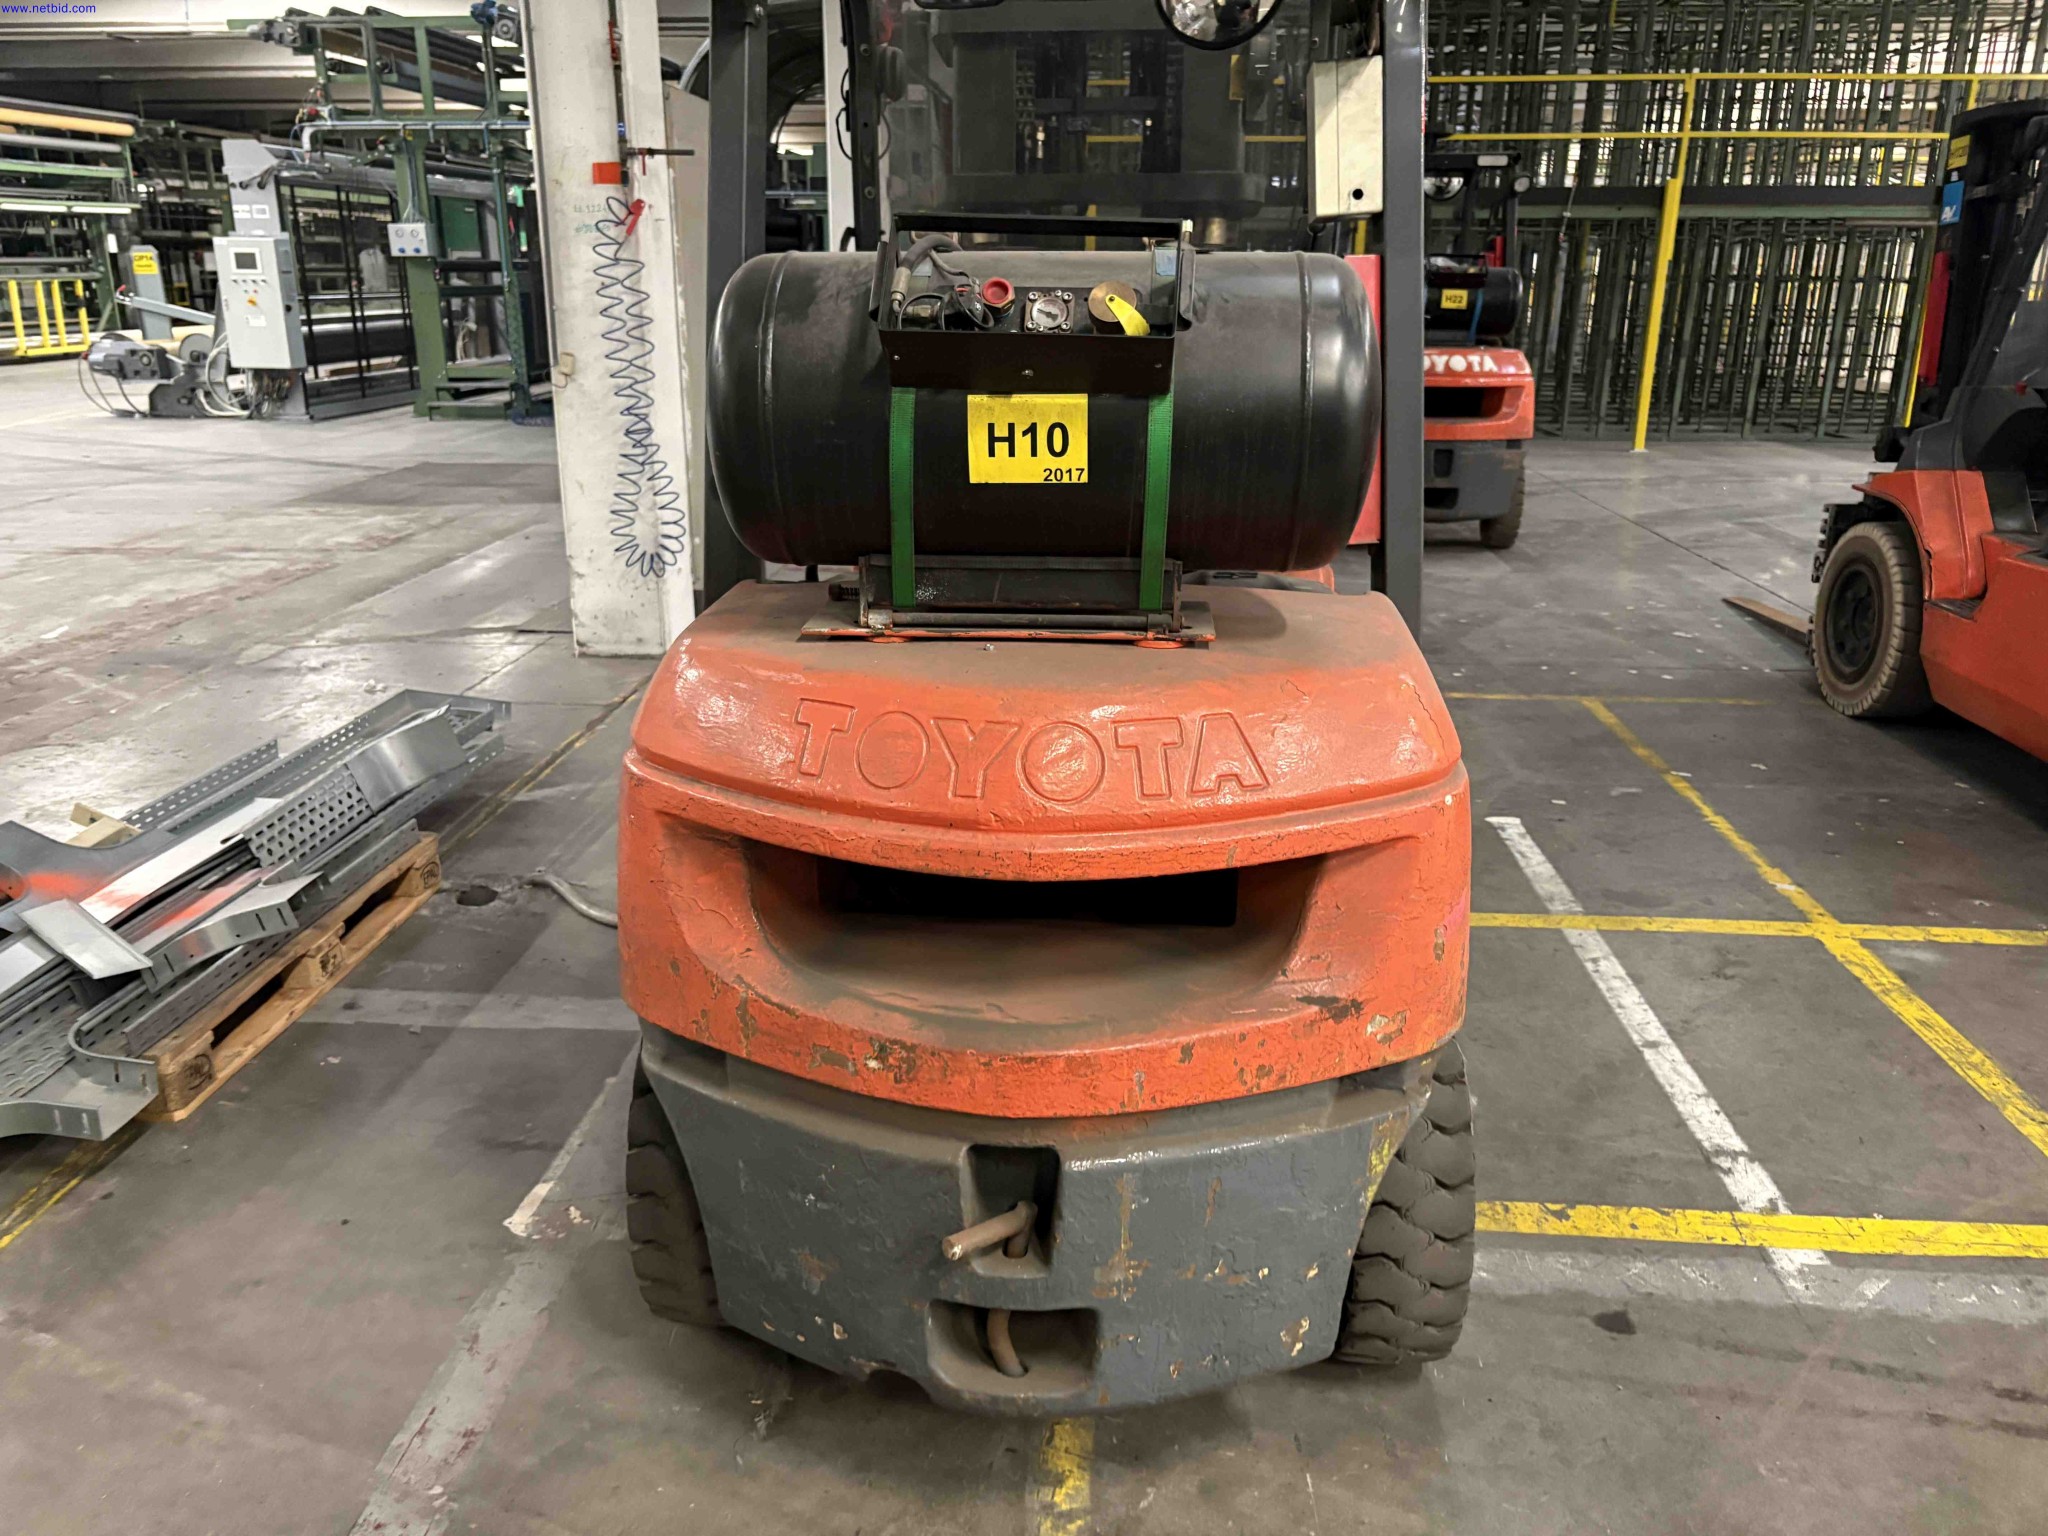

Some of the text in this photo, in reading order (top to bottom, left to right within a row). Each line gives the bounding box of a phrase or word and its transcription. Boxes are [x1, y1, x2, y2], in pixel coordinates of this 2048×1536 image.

[1445, 295, 1464, 304] H22
[987, 421, 1070, 458] H10
[1043, 467, 1086, 482] 2017
[795, 698, 1270, 802] TOYOTA
